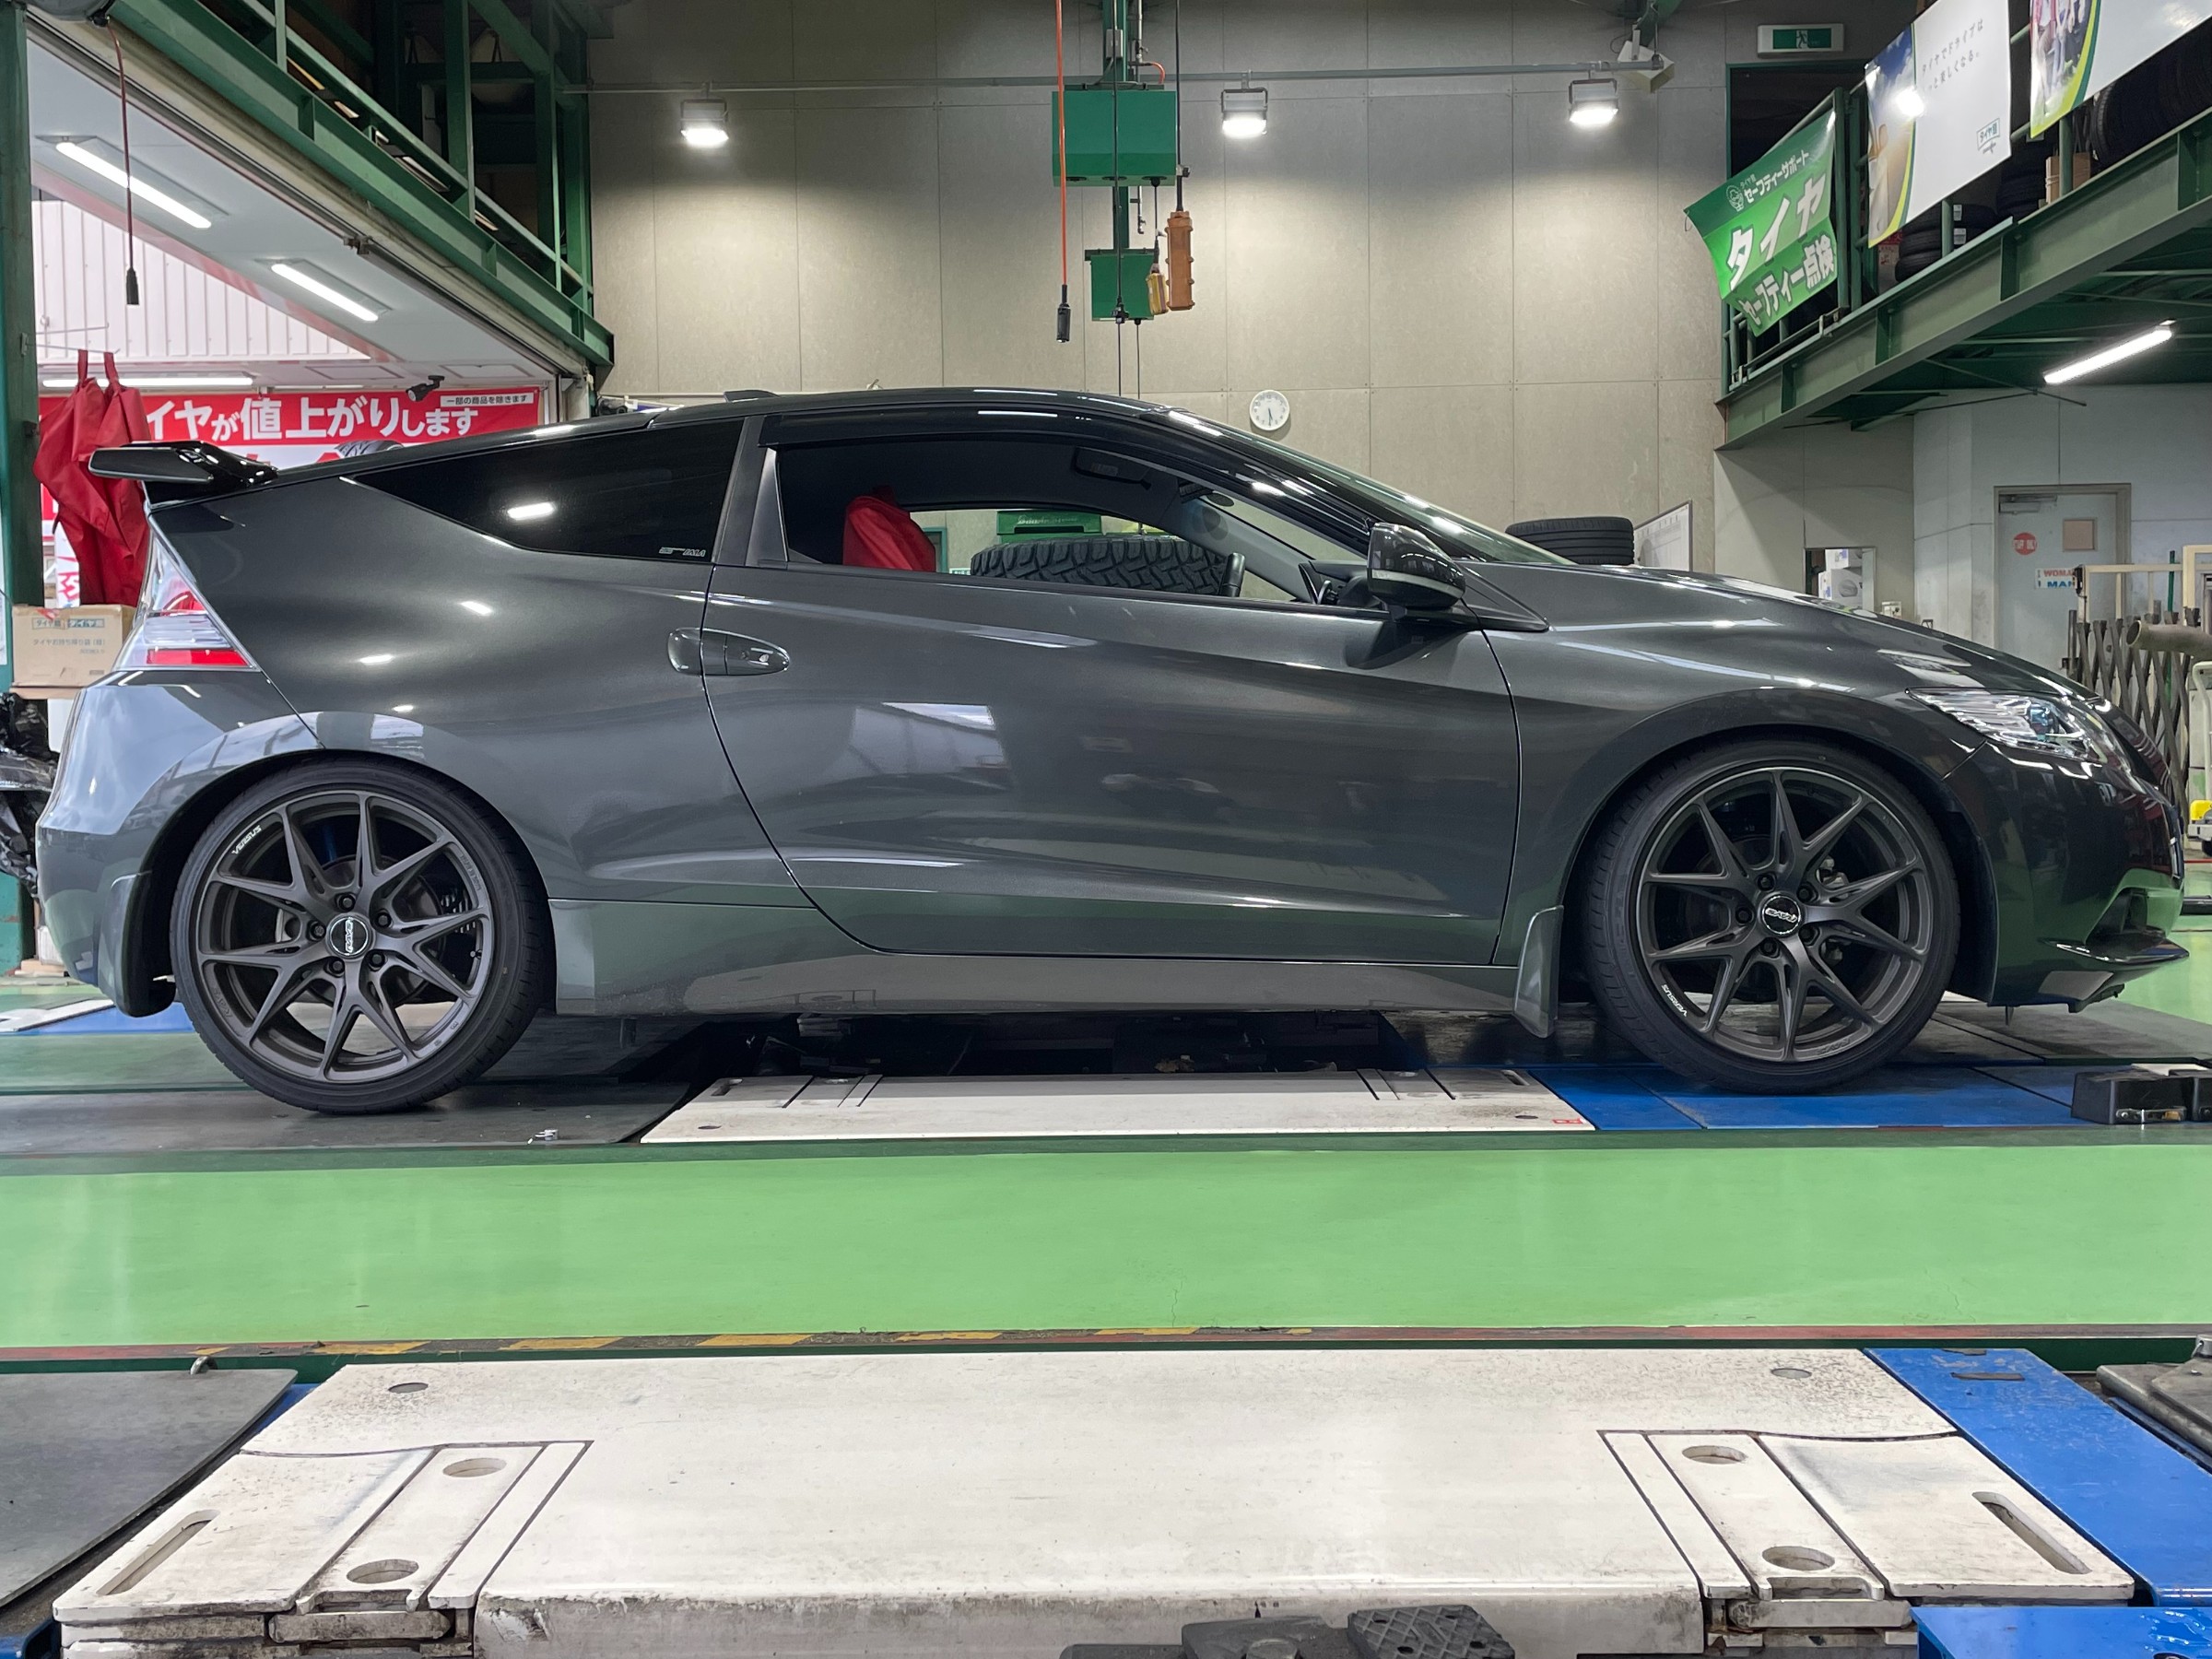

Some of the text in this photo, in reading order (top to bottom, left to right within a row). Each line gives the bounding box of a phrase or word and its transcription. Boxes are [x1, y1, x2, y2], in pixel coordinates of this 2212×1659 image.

[1923, 50, 1980, 91] っと楽しくなる。
[1744, 149, 1809, 204] セーフティーサポート
[1726, 172, 1826, 291] タイヤ
[147, 395, 478, 441] イヤが値上がりします
[446, 394, 528, 406] 一部の商品を除きます
[231, 825, 262, 854] VERSUS
[1661, 983, 1688, 1017] VERSUS
